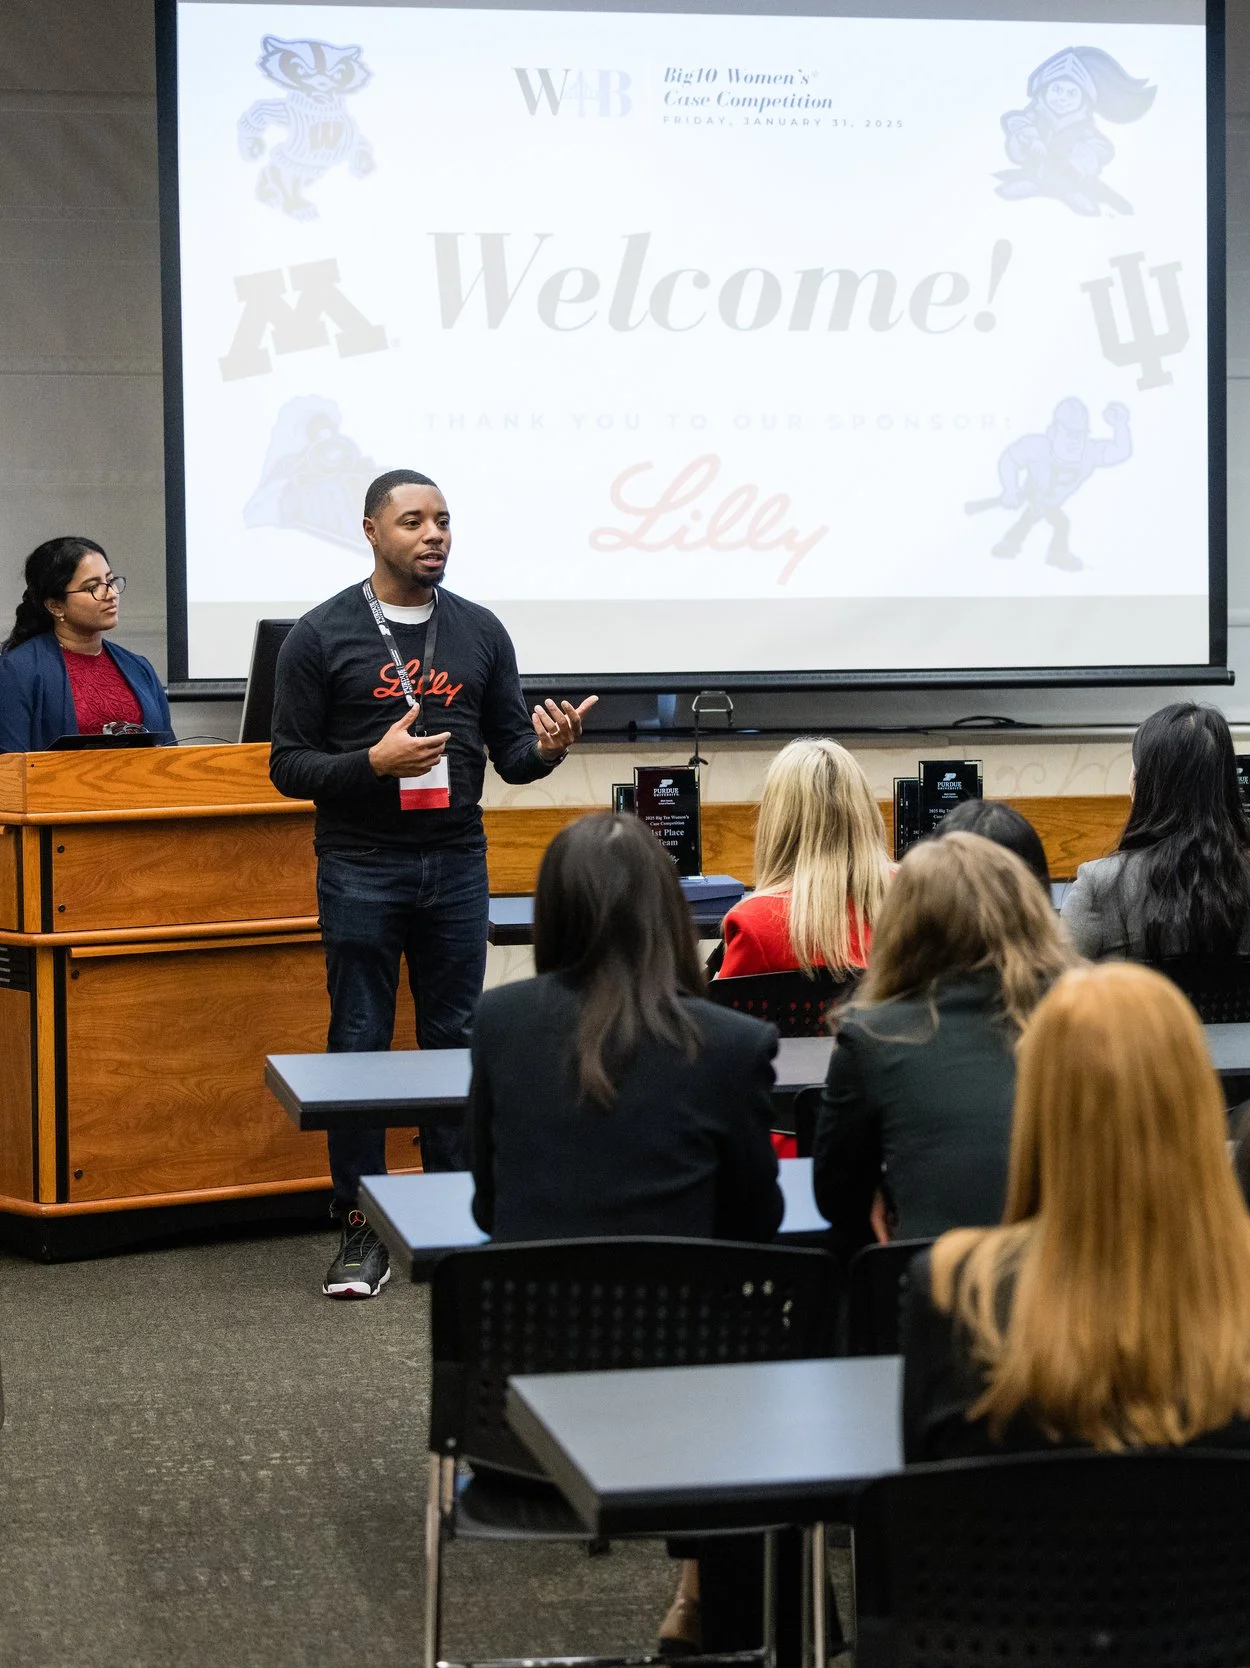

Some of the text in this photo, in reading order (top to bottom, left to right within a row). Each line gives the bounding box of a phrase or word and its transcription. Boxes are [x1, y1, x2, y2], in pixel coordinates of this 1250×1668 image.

[663, 66, 718, 86] Big10
[663, 90, 833, 113] Case Competition
[663, 116, 903, 129] FRIDAY, JANUARY 31, 2025
[426, 231, 1013, 335] Welcome!
[424, 412, 1012, 432] THANK YOU TO OUR SPONSOR:
[588, 452, 830, 586] Lilly
[372, 658, 464, 708] Llly
[664, 828, 685, 836] Place
